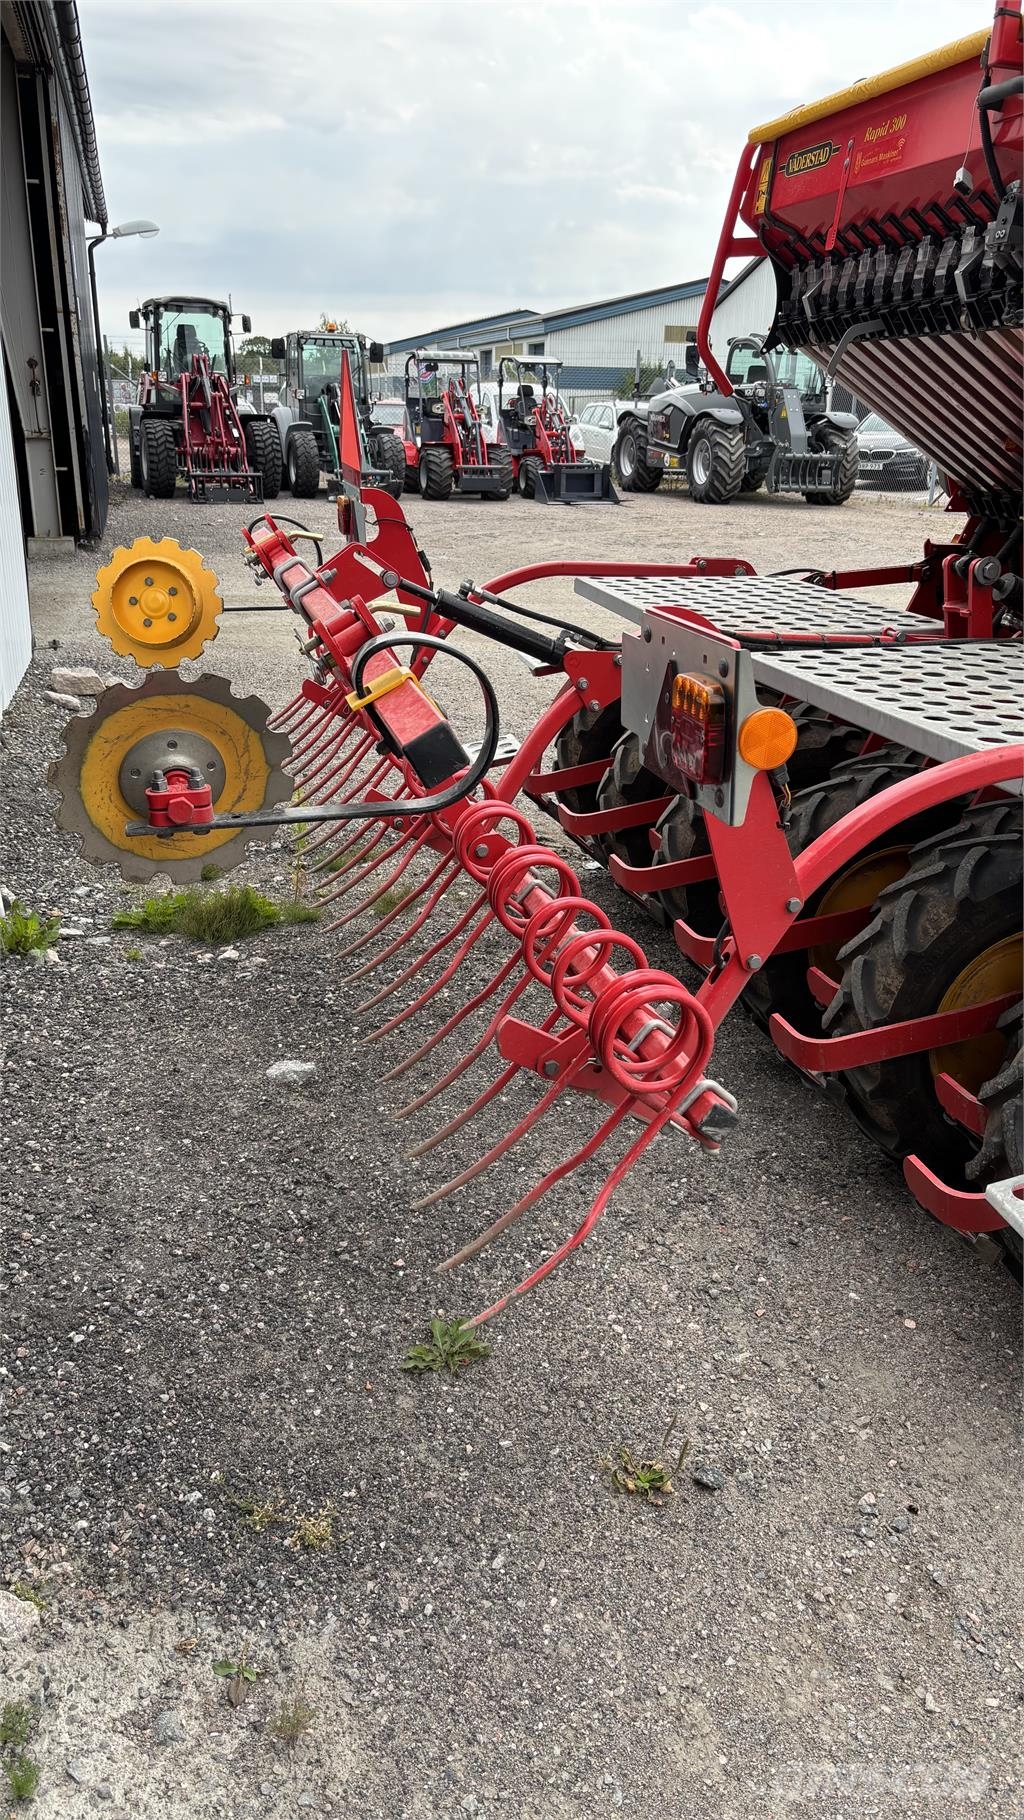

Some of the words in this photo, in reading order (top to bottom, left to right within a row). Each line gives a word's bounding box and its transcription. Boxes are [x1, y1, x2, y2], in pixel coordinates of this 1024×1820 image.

[864, 120, 890, 142] Rapid
[890, 114, 907, 133] 300
[789, 147, 829, 172] VÄDERSTAD
